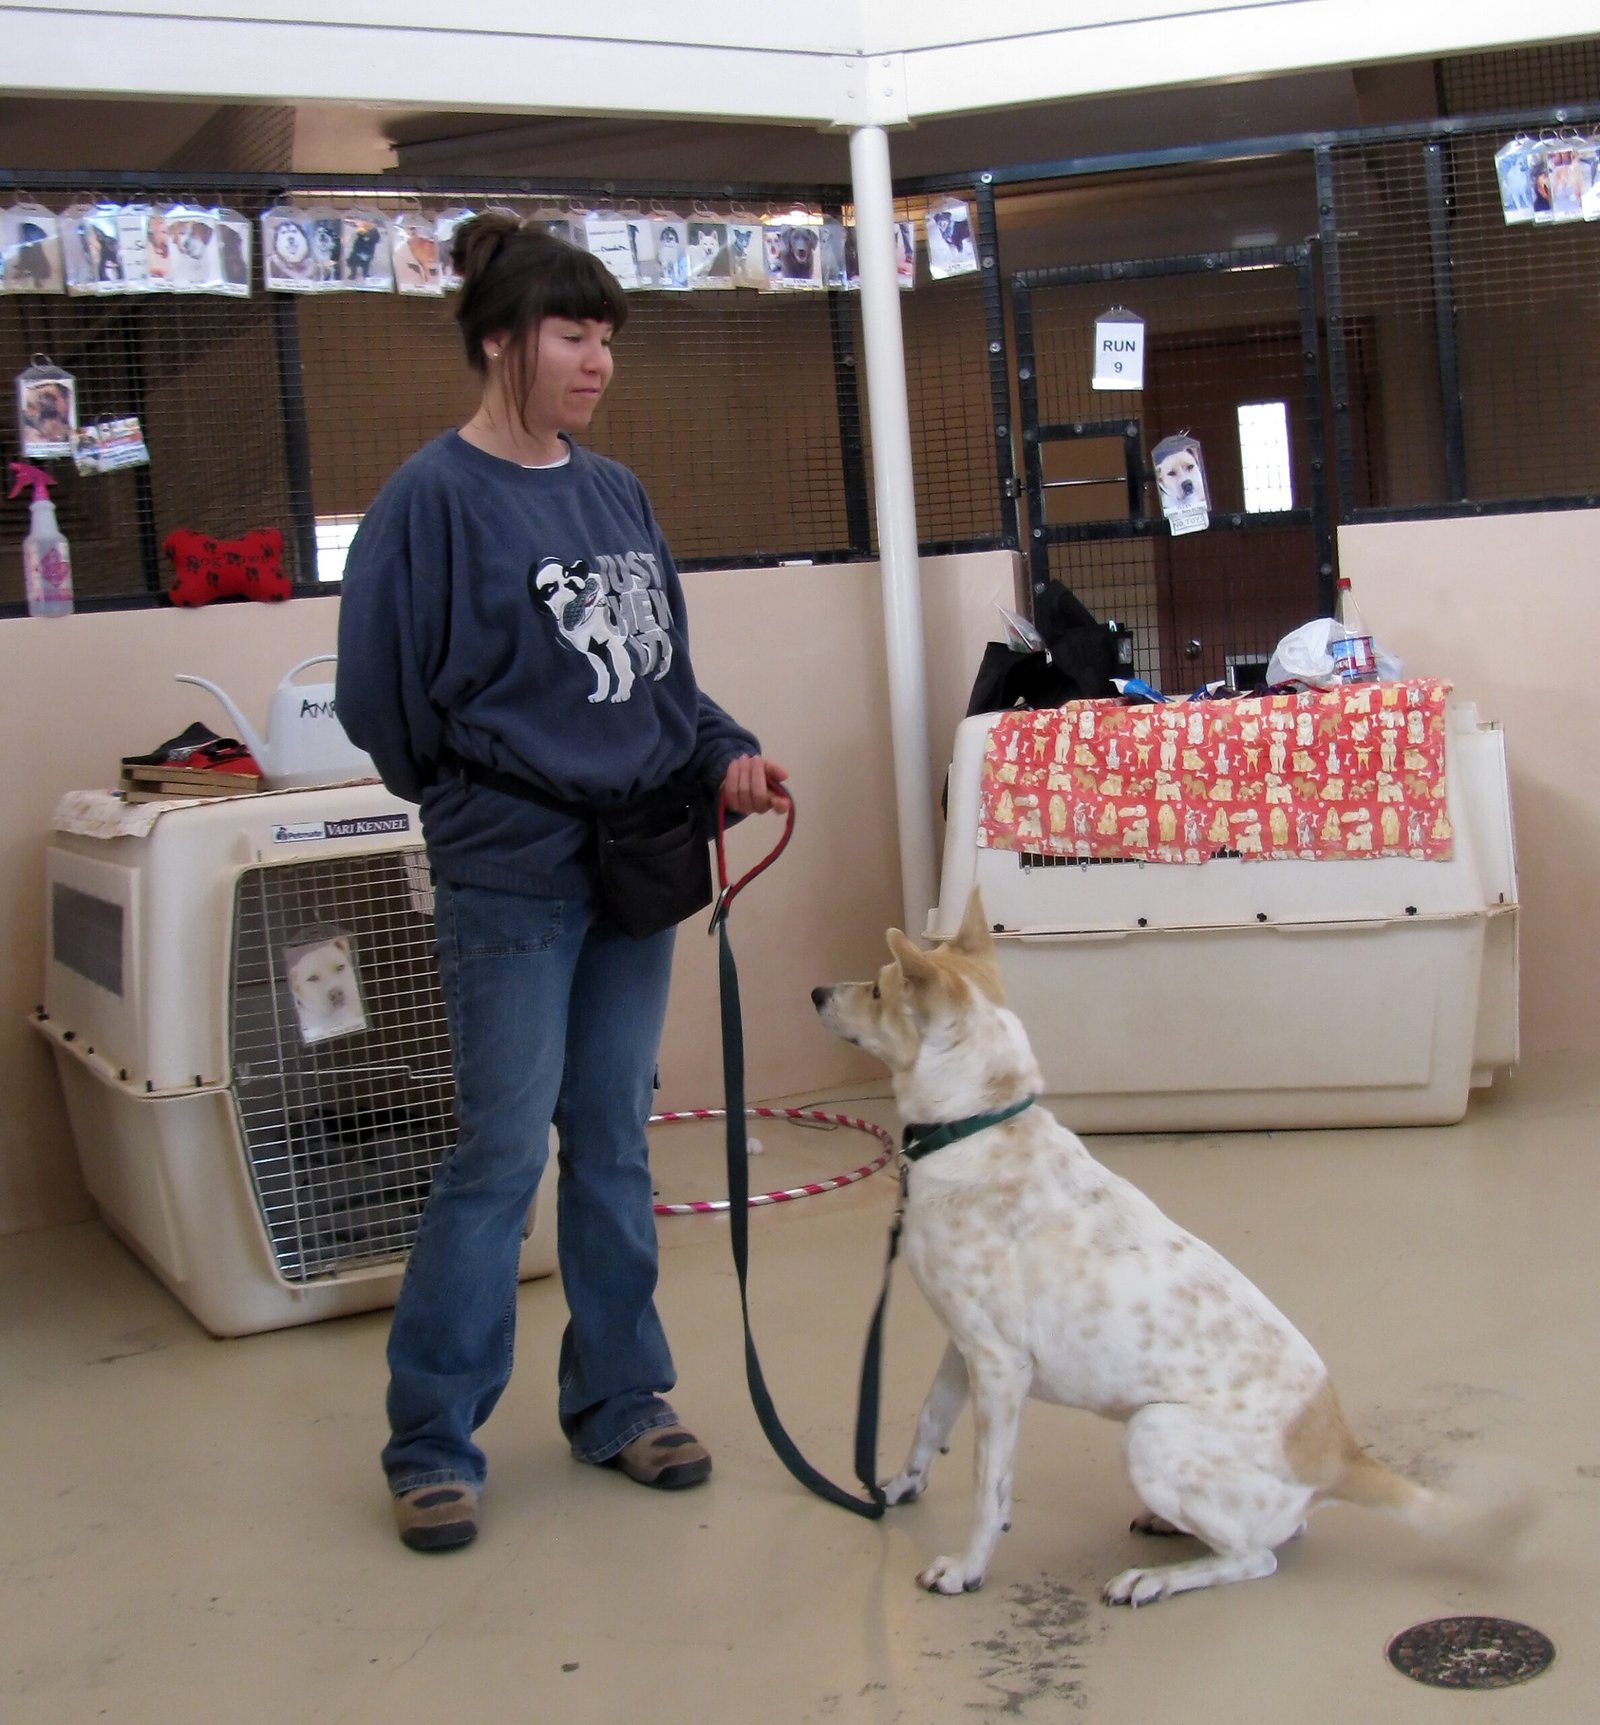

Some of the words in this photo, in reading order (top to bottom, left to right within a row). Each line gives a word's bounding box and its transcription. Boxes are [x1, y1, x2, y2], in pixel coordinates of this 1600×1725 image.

[1103, 340, 1136, 352] RUN
[1114, 361, 1123, 373] 9
[595, 551, 662, 595] JUST
[288, 830, 323, 840] Petmate
[326, 822, 355, 836] VARI
[356, 818, 407, 834] KENNEL
